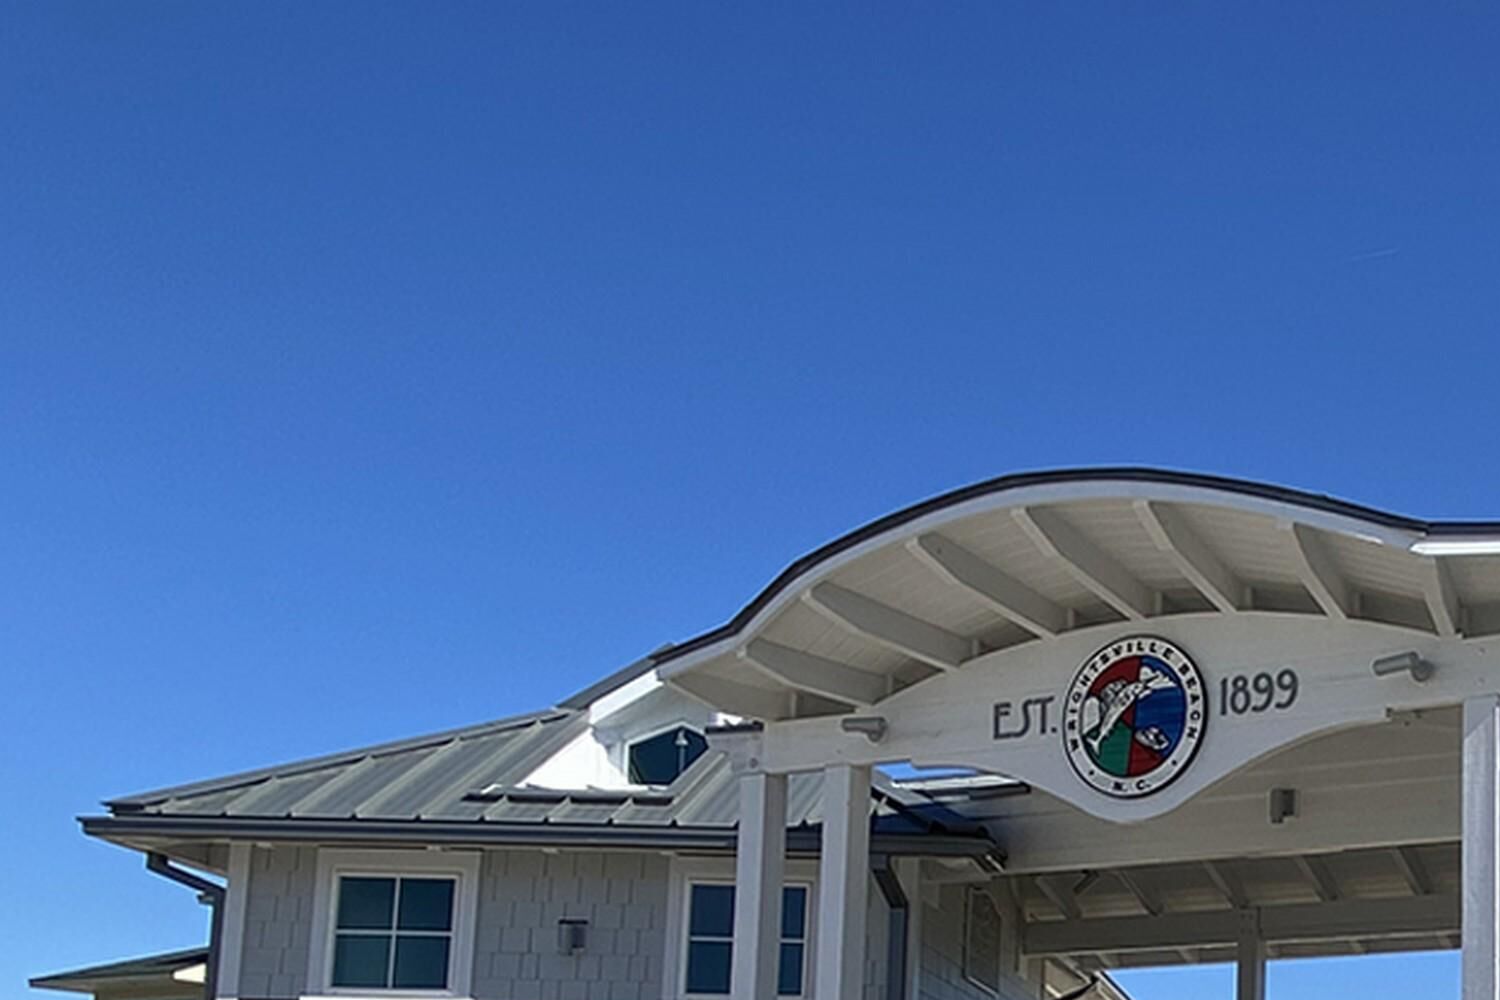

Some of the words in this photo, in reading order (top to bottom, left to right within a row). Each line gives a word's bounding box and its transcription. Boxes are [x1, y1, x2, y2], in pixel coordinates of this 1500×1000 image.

[993, 696, 1058, 740] EST.
[1220, 668, 1299, 716] 1899
[1068, 641, 1174, 752] WRIGHTSVILLE
[1178, 663, 1201, 739] BEACH
